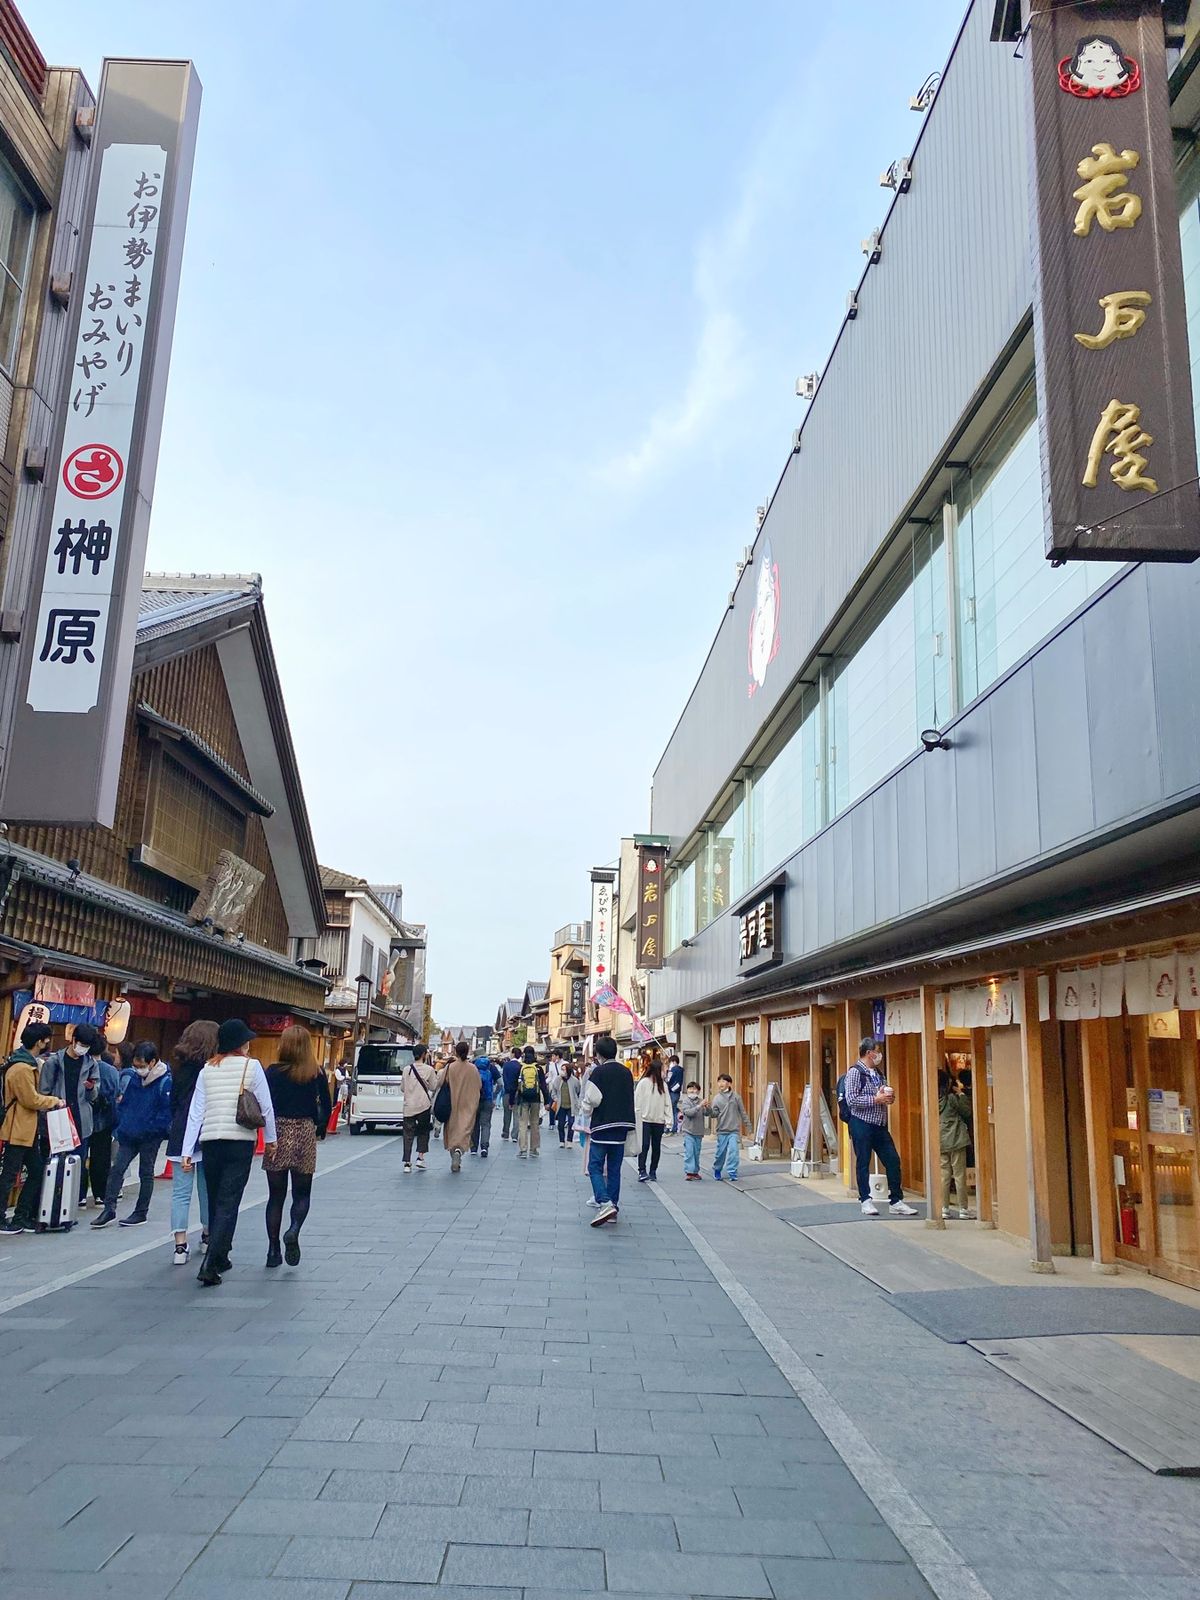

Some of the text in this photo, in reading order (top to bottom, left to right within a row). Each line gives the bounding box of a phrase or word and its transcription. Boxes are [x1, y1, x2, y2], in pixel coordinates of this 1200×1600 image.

[116, 171, 161, 376] お伊勢まいり
[1073, 142, 1159, 493] 岩戸屋
[73, 283, 116, 418] おみやげ
[39, 518, 112, 664] 榊原
[641, 882, 658, 957] 岩戸屋
